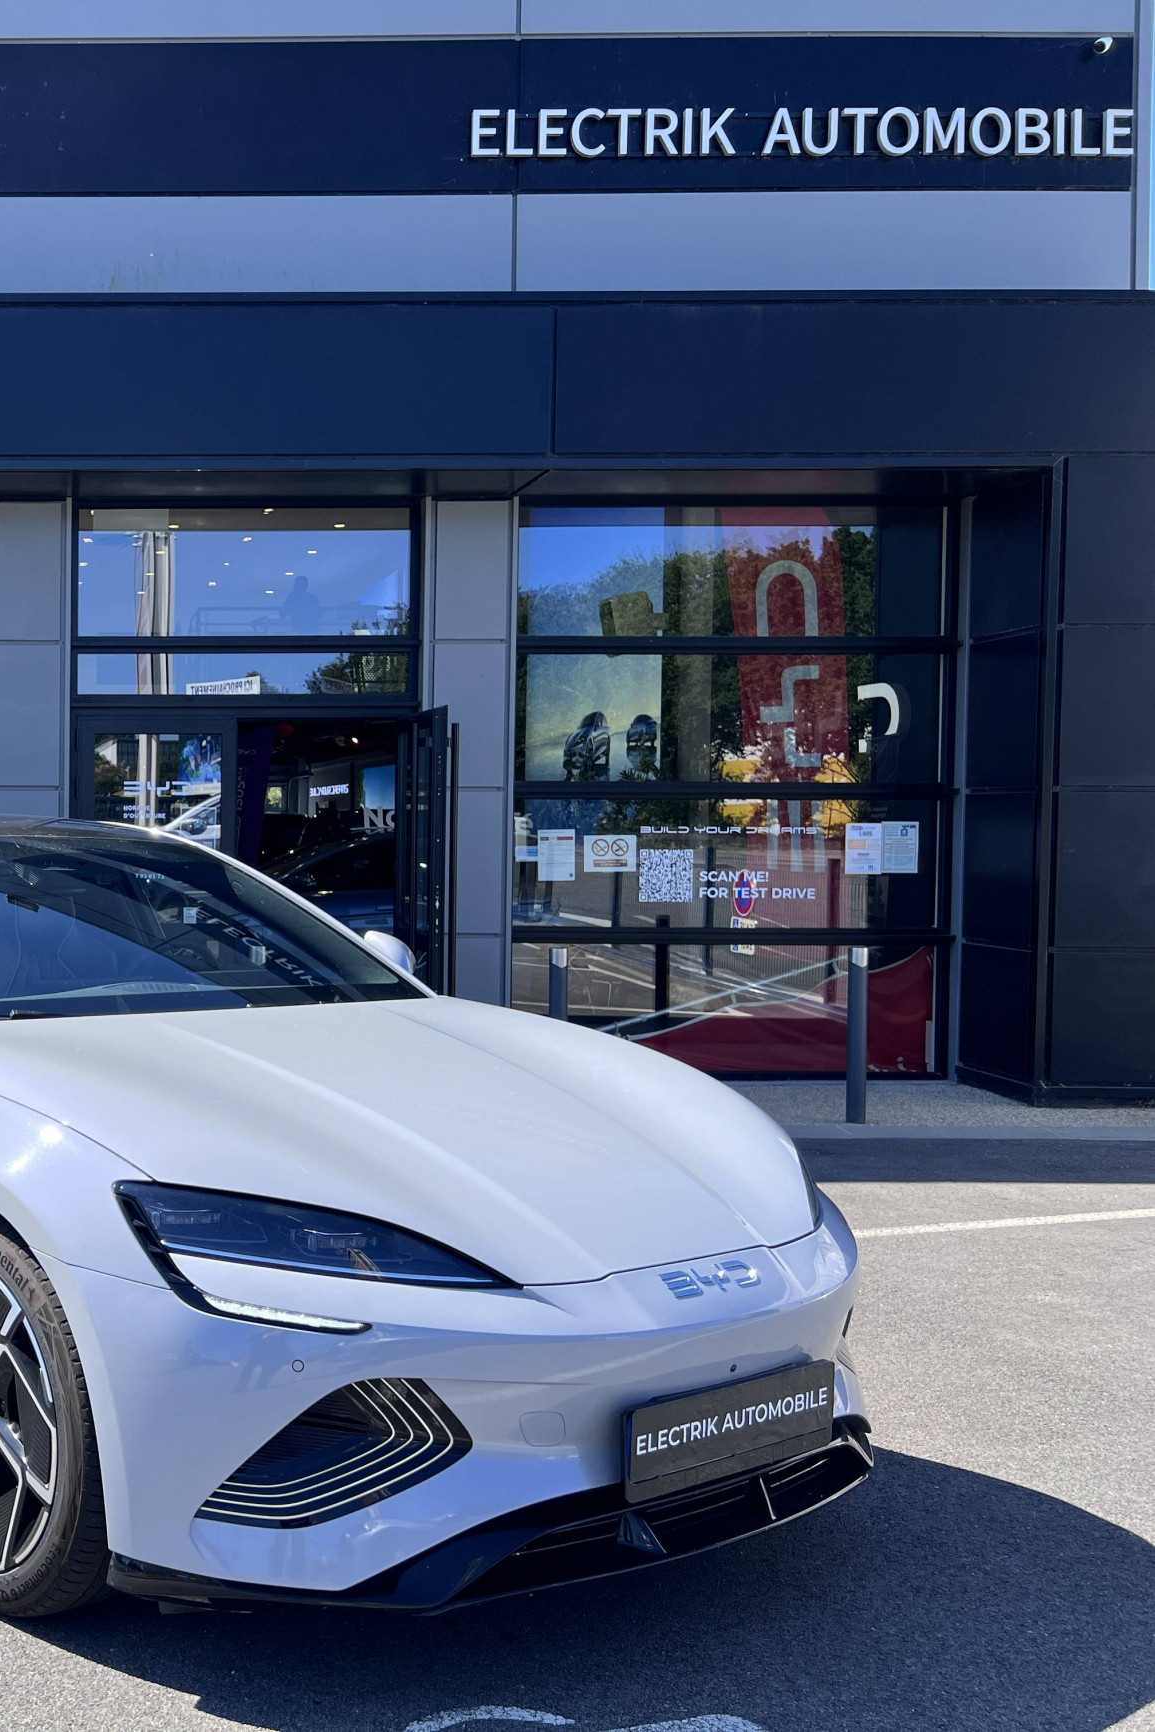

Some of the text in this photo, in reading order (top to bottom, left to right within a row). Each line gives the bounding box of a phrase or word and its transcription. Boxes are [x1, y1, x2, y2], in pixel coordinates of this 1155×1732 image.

[471, 106, 1135, 157] ELECTRIK AUTOMOBILE
[123, 781, 193, 797] BYD
[639, 825, 818, 834] BUILD YOUR DREAMS
[699, 870, 769, 883] SCAN ME!
[699, 887, 816, 899] FOR TEST DRIVE
[658, 1260, 761, 1300] BYD
[636, 1387, 828, 1455] ELECTRIK AUTOMOBILE
